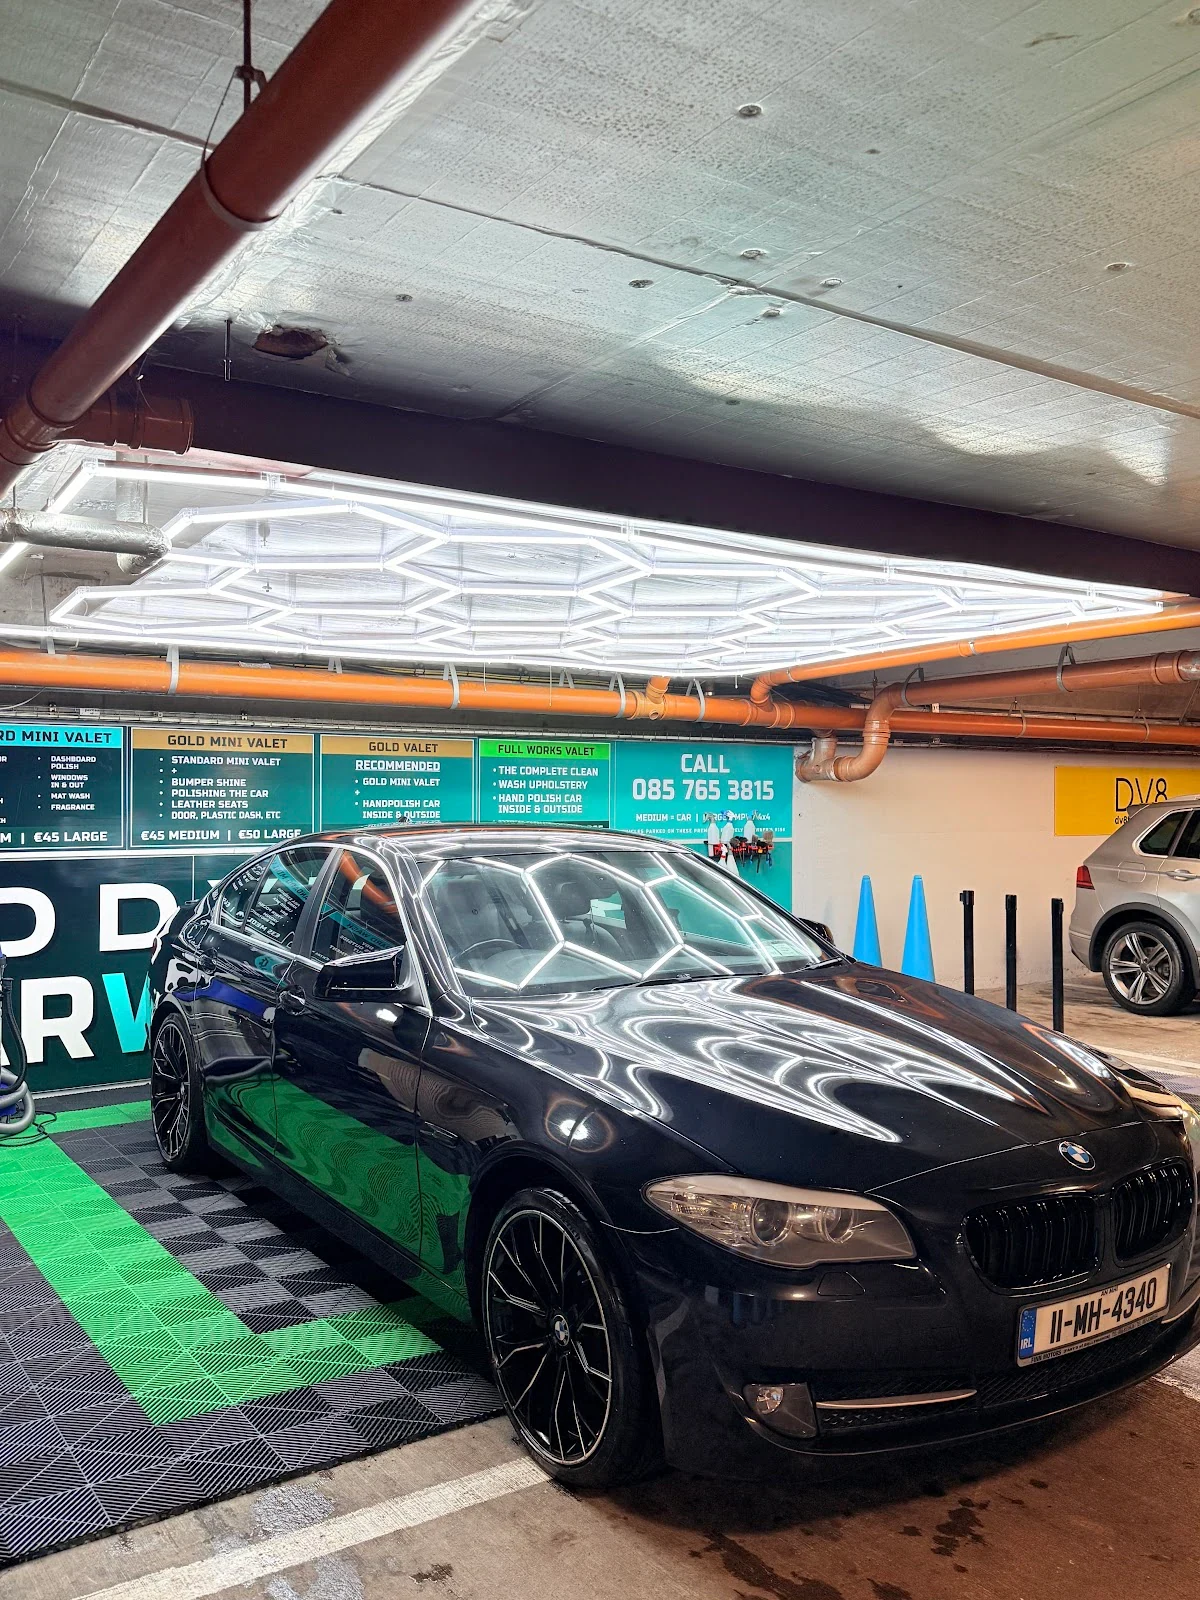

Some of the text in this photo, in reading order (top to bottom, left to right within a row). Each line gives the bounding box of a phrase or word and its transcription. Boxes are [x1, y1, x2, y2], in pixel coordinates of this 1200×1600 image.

[22, 731, 59, 742] MINI
[64, 732, 112, 743] VALET
[168, 735, 288, 749] GOLD MINI VALET
[369, 741, 439, 753] GOLD VALET
[498, 744, 595, 756] FULL WORKS VALET
[171, 756, 282, 766] STANDARD MINI VALET
[355, 760, 440, 772] RECOMMENDED
[681, 753, 730, 773] CALL
[498, 766, 599, 777] THE COMPLETE CLEAN
[171, 779, 247, 787] BUMPER SHINE
[362, 778, 440, 786] GOLD MINI VALET
[498, 780, 589, 790] WASH UPHOLSTERY
[171, 789, 269, 798] POLISHING THE CAR
[632, 778, 775, 800] 085 765 3815
[1115, 777, 1168, 812] DV8
[362, 799, 440, 808] HANDPOLISH CAR
[498, 794, 583, 803] HAND POLISH CAR
[171, 800, 249, 809] LEATHER SEATS
[498, 804, 583, 814] INSIDE & OUTSIDE
[171, 811, 281, 820] DOOR, PLASTIC DASH, ETC
[362, 811, 393, 819] INSIDE
[403, 811, 440, 819] OUTSIDE
[635, 813, 669, 822] MEDIUM
[676, 813, 692, 822] CAR
[33, 832, 60, 843] €45
[64, 831, 108, 842] LARGE
[140, 830, 165, 841] €45
[168, 830, 220, 840] MEDIUM
[238, 829, 261, 839] €50
[1050, 1277, 1157, 1344] 11-MH-4340
[1020, 1337, 1033, 1350] IRL
